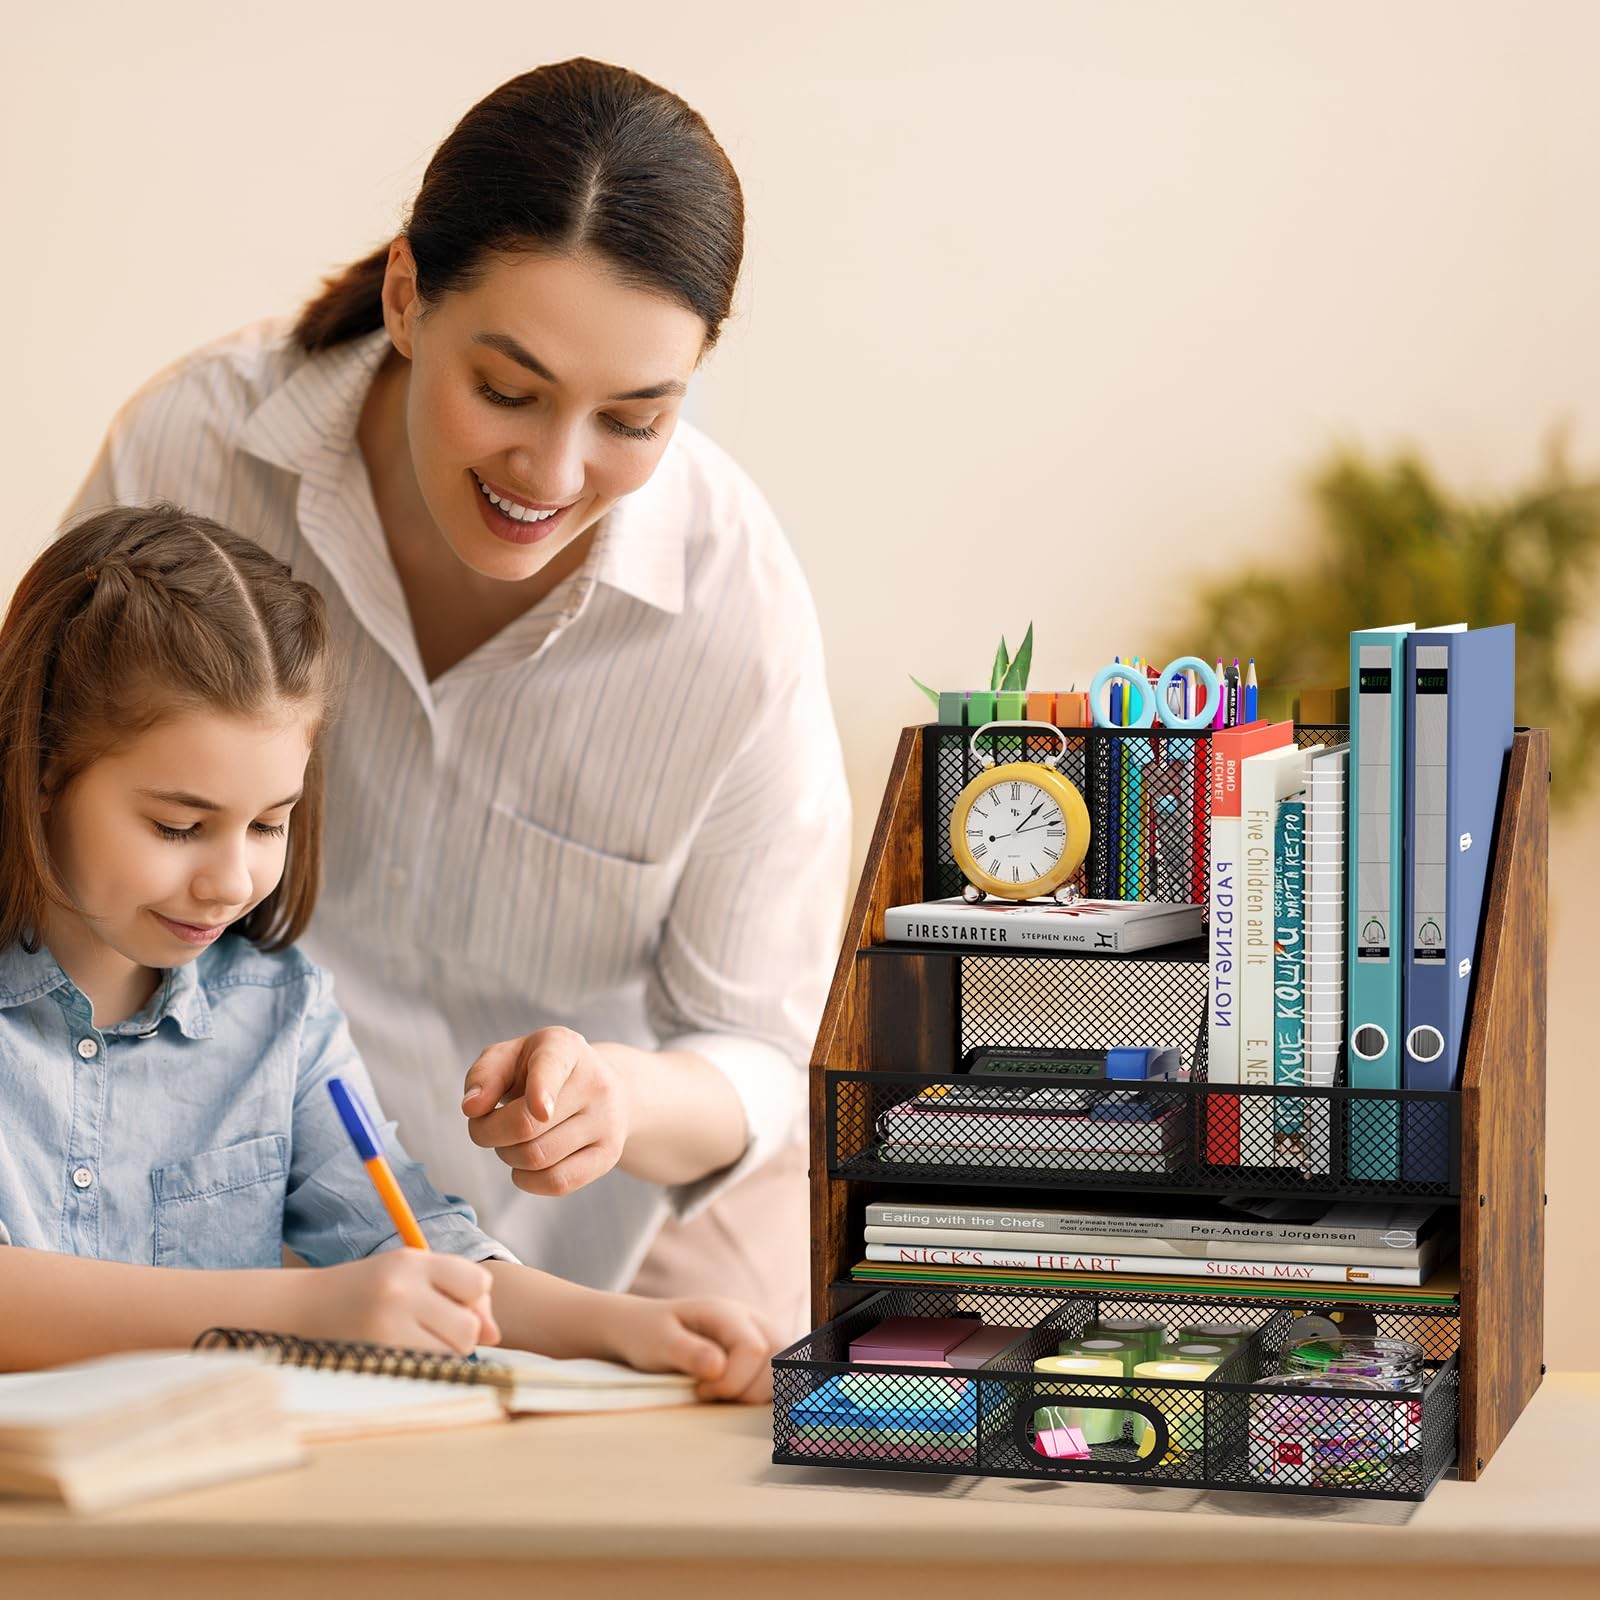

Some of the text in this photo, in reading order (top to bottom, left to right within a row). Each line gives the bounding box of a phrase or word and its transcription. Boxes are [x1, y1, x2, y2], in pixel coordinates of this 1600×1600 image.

[1367, 676, 1389, 686] LEITZ
[1423, 677, 1445, 687] LEITZ
[1247, 810, 1269, 966] Five Children and It
[906, 923, 1008, 943] FIRESTARTER
[1021, 932, 1086, 944] STEPHEN KING
[1247, 1039, 1268, 1051] E.
[882, 1212, 1046, 1229] Eating with the Chefs
[1060, 1218, 1083, 1226] Family
[1191, 1225, 1356, 1242] Per-Anders Jorgensen
[993, 1259, 1026, 1267] NEW
[1037, 1255, 1121, 1272] HEART
[1205, 1261, 1315, 1279] SUSAN MAY
